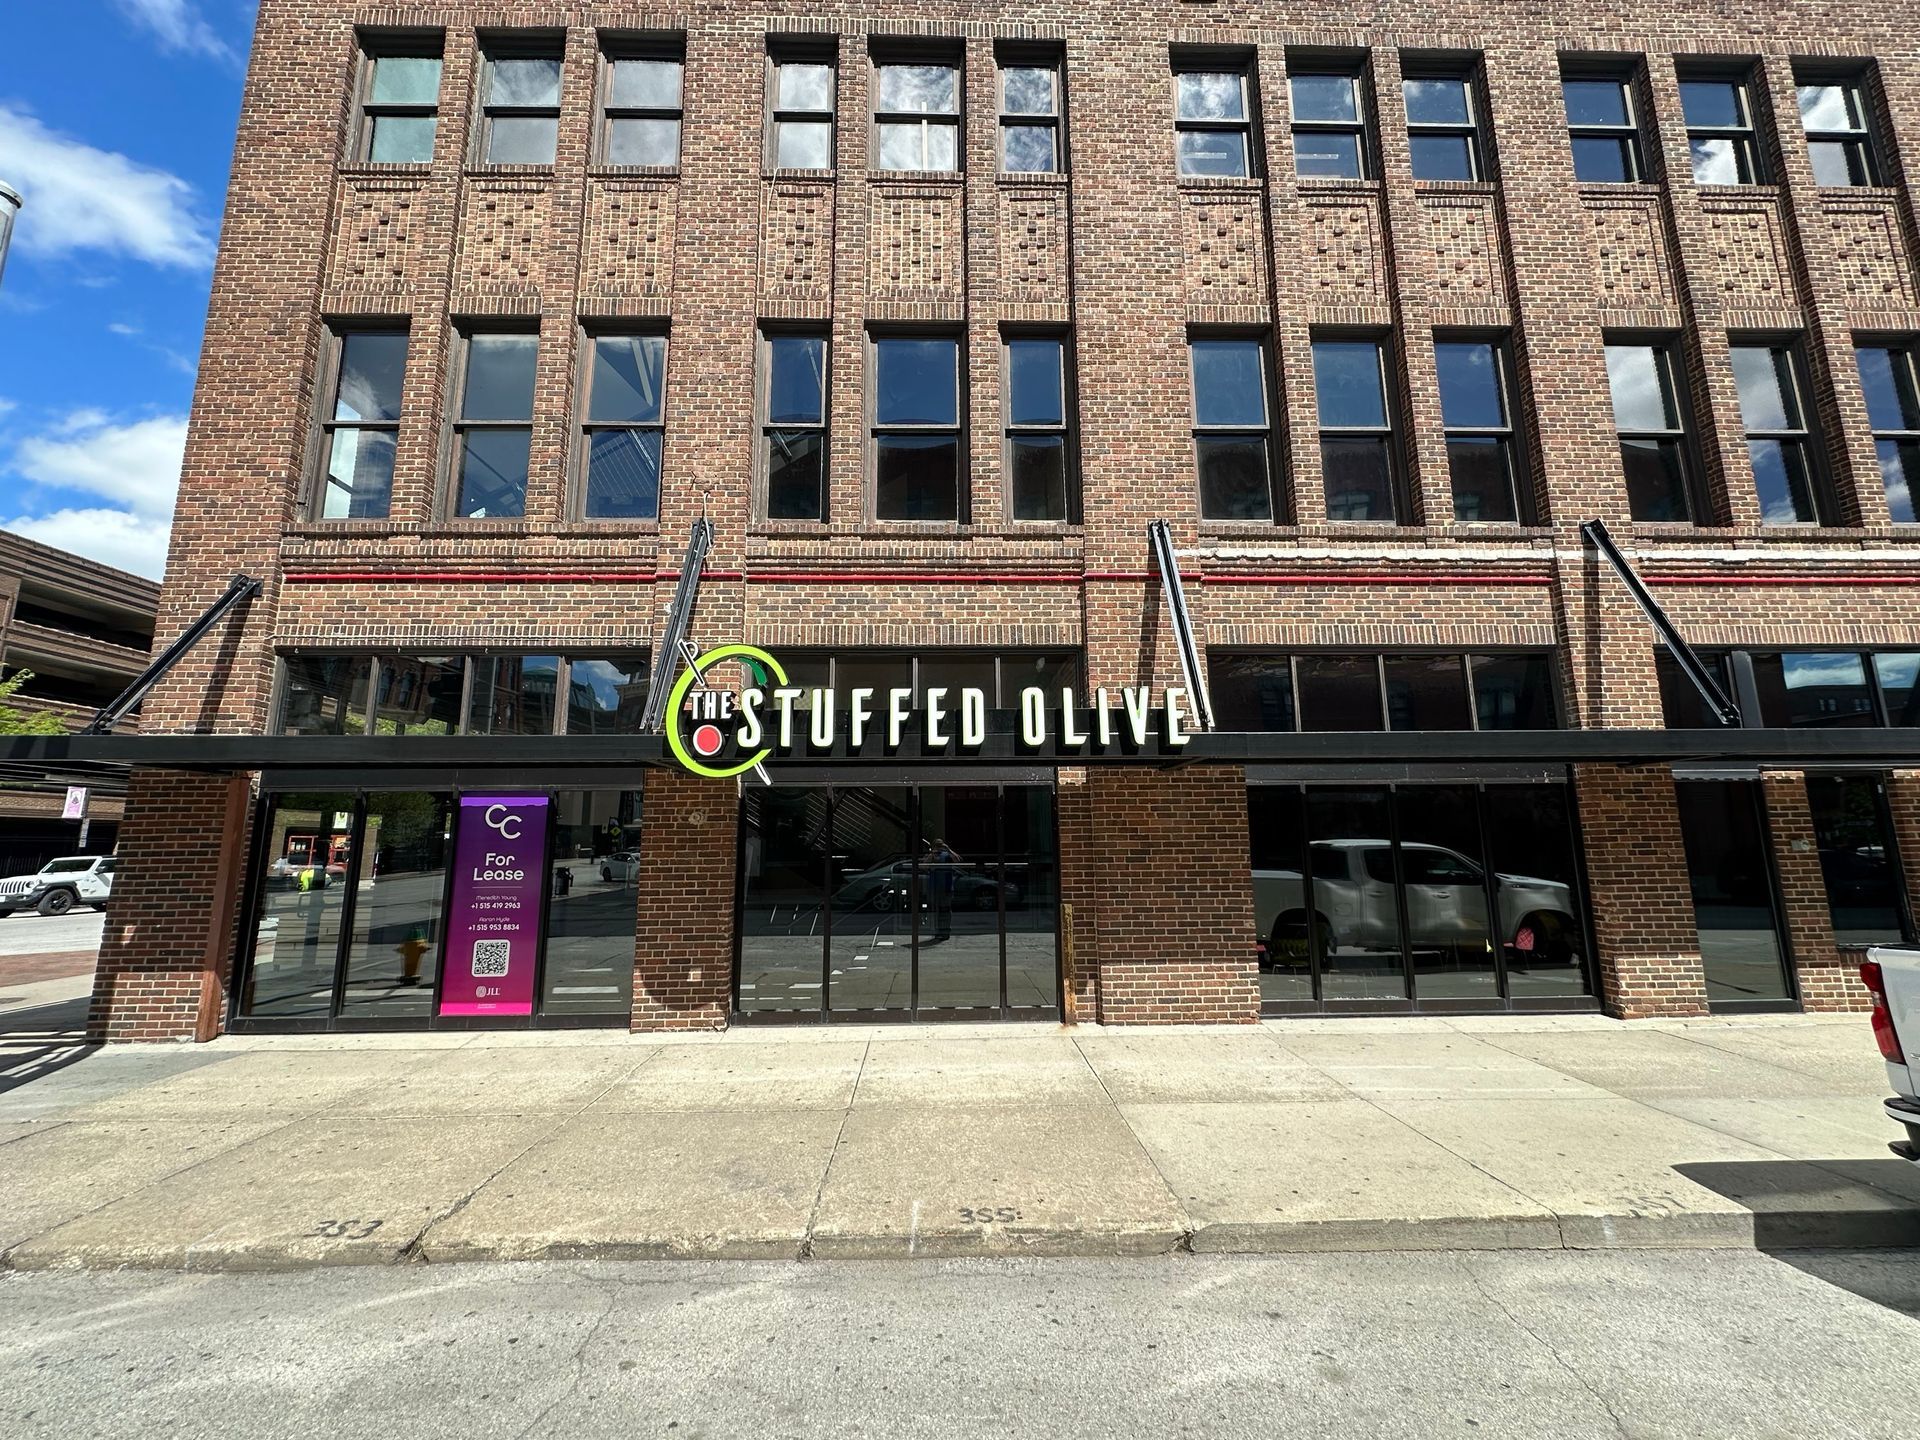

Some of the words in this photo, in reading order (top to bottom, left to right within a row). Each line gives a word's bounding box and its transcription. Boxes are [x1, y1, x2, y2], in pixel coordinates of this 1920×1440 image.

[688, 691, 732, 719] THE
[737, 688, 984, 748] STUFFED
[1021, 686, 1191, 746] OLIVE
[485, 852, 515, 867] For
[473, 867, 524, 881] Lease
[486, 987, 501, 996] JLL
